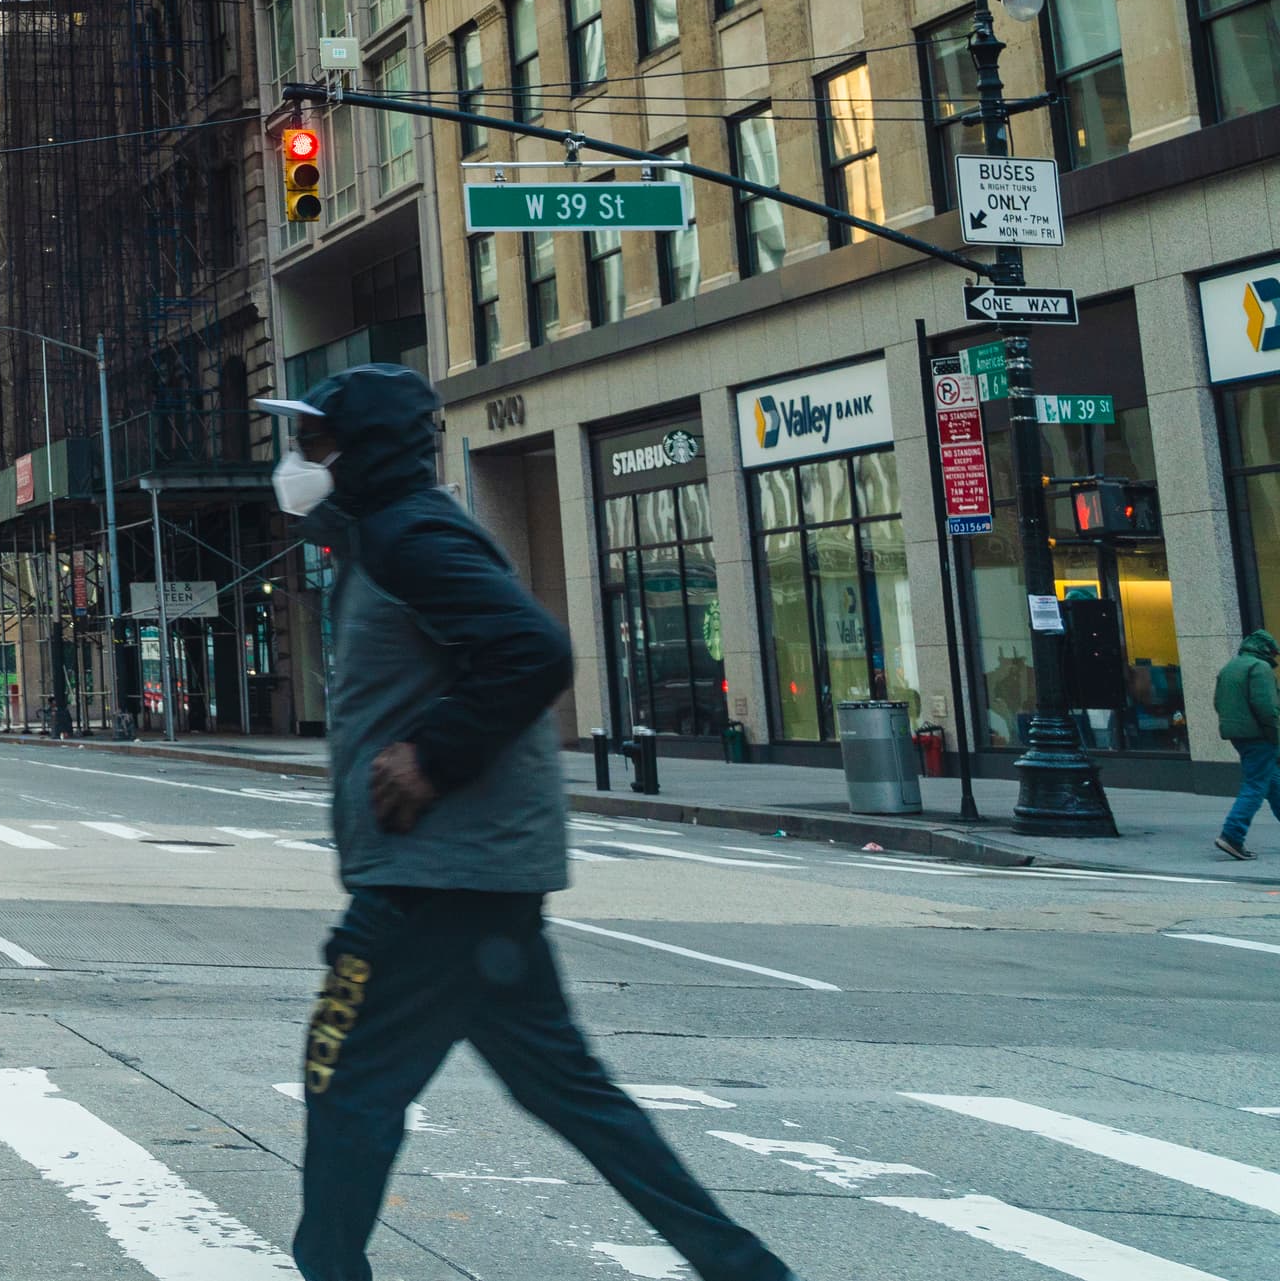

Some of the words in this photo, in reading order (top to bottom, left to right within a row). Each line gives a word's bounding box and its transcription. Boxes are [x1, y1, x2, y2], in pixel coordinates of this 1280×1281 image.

[979, 163, 1035, 181] BUSES
[1012, 184, 1037, 192] TURNS
[525, 194, 544, 219] W
[556, 193, 587, 219] 39
[599, 193, 625, 219] St
[988, 194, 1031, 211] ONLY
[999, 227, 1018, 237] MON
[1041, 228, 1056, 239] FRI
[982, 297, 1013, 312] ONE
[1028, 299, 1060, 312] WAY
[993, 377, 1000, 395] 6
[950, 411, 977, 421] STANDING
[1059, 400, 1071, 420] W
[1077, 400, 1095, 420] 39
[1100, 400, 1110, 413] St
[780, 395, 832, 444] Valley
[836, 395, 874, 420] BANK
[612, 443, 677, 476] STARBU
[943, 450, 953, 458] NO
[954, 448, 982, 457] STANDING
[953, 457, 973, 465] EXCEPT
[155, 592, 193, 602] TEEN
[836, 620, 864, 644] Valle
